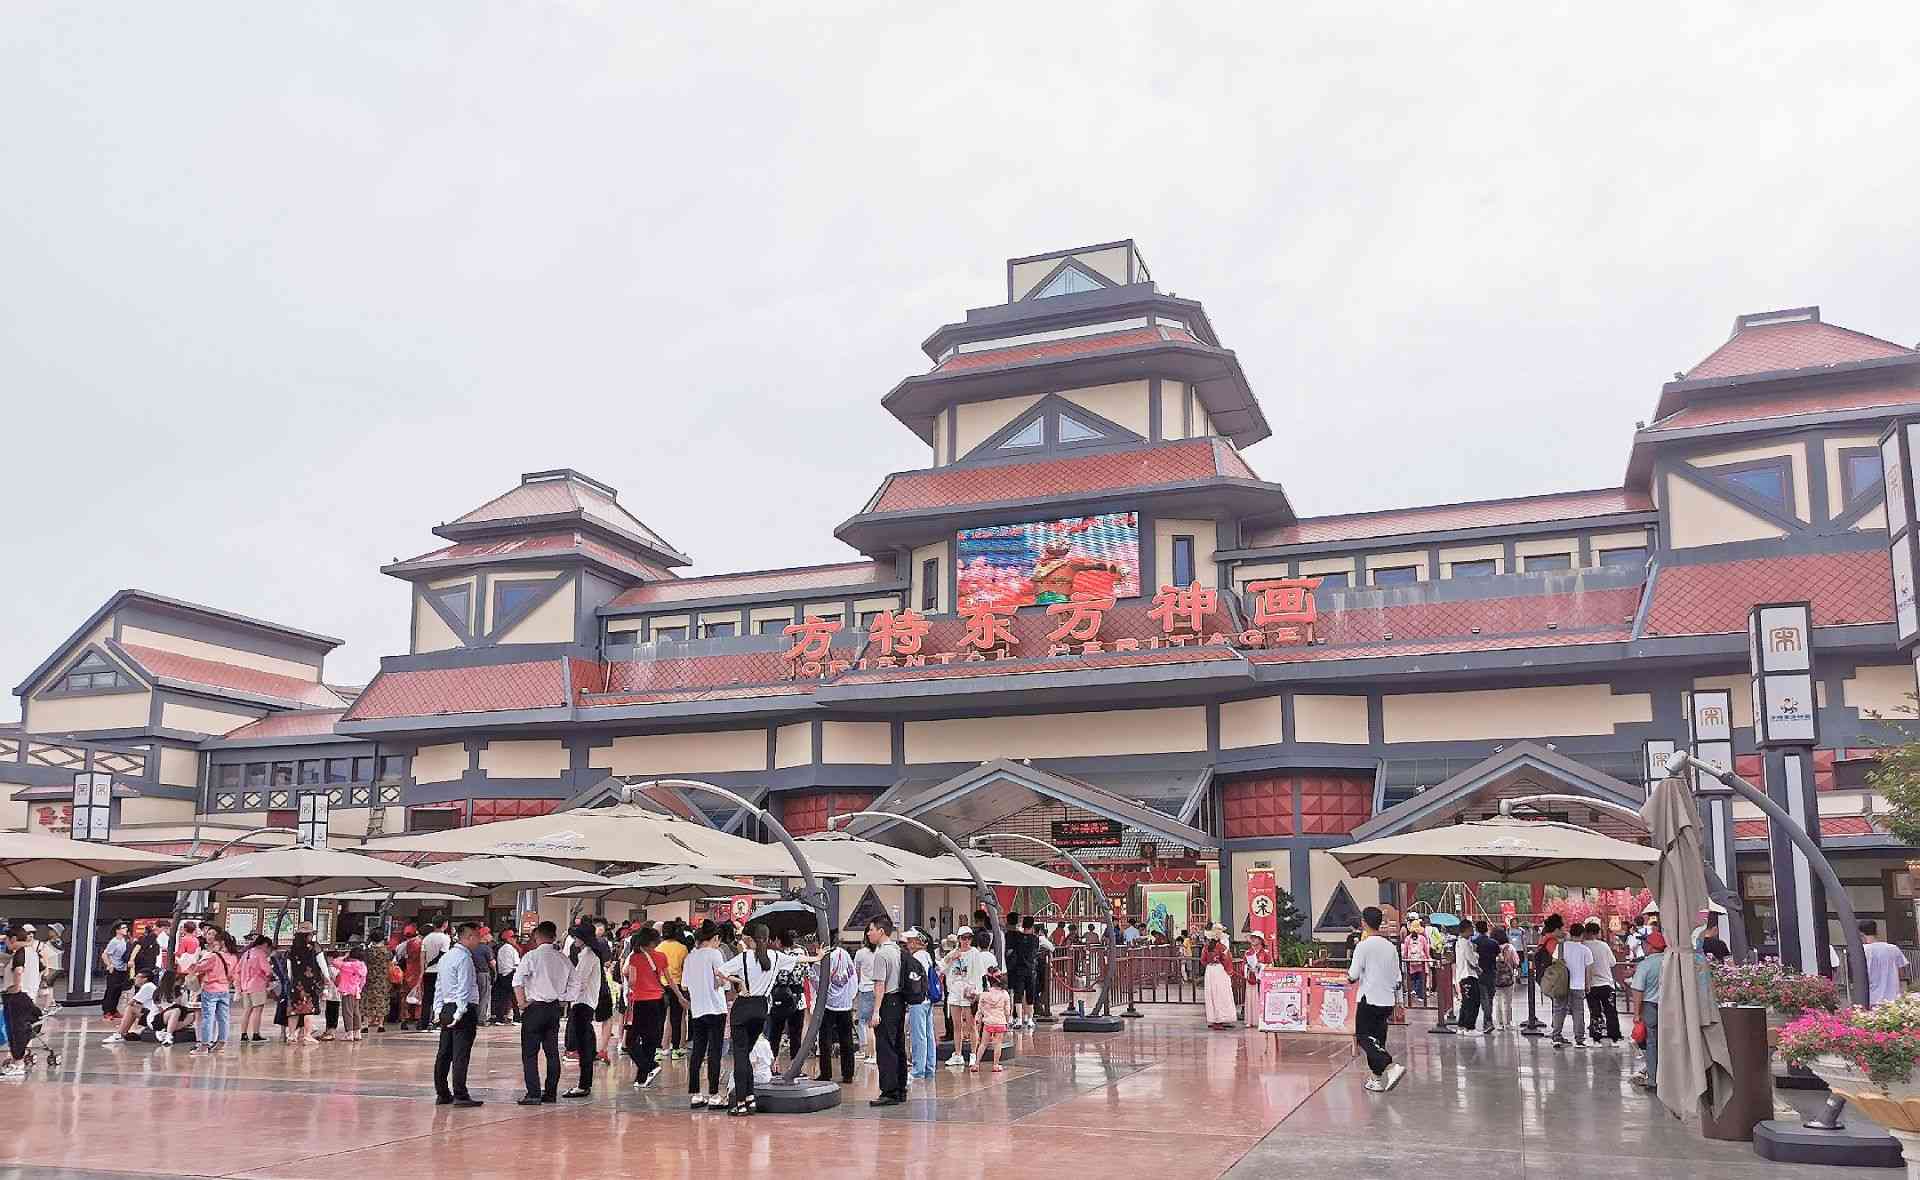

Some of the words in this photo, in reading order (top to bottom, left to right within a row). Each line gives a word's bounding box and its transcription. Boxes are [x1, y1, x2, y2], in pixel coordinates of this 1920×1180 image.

[782, 577, 1324, 662] 方特东方神画
